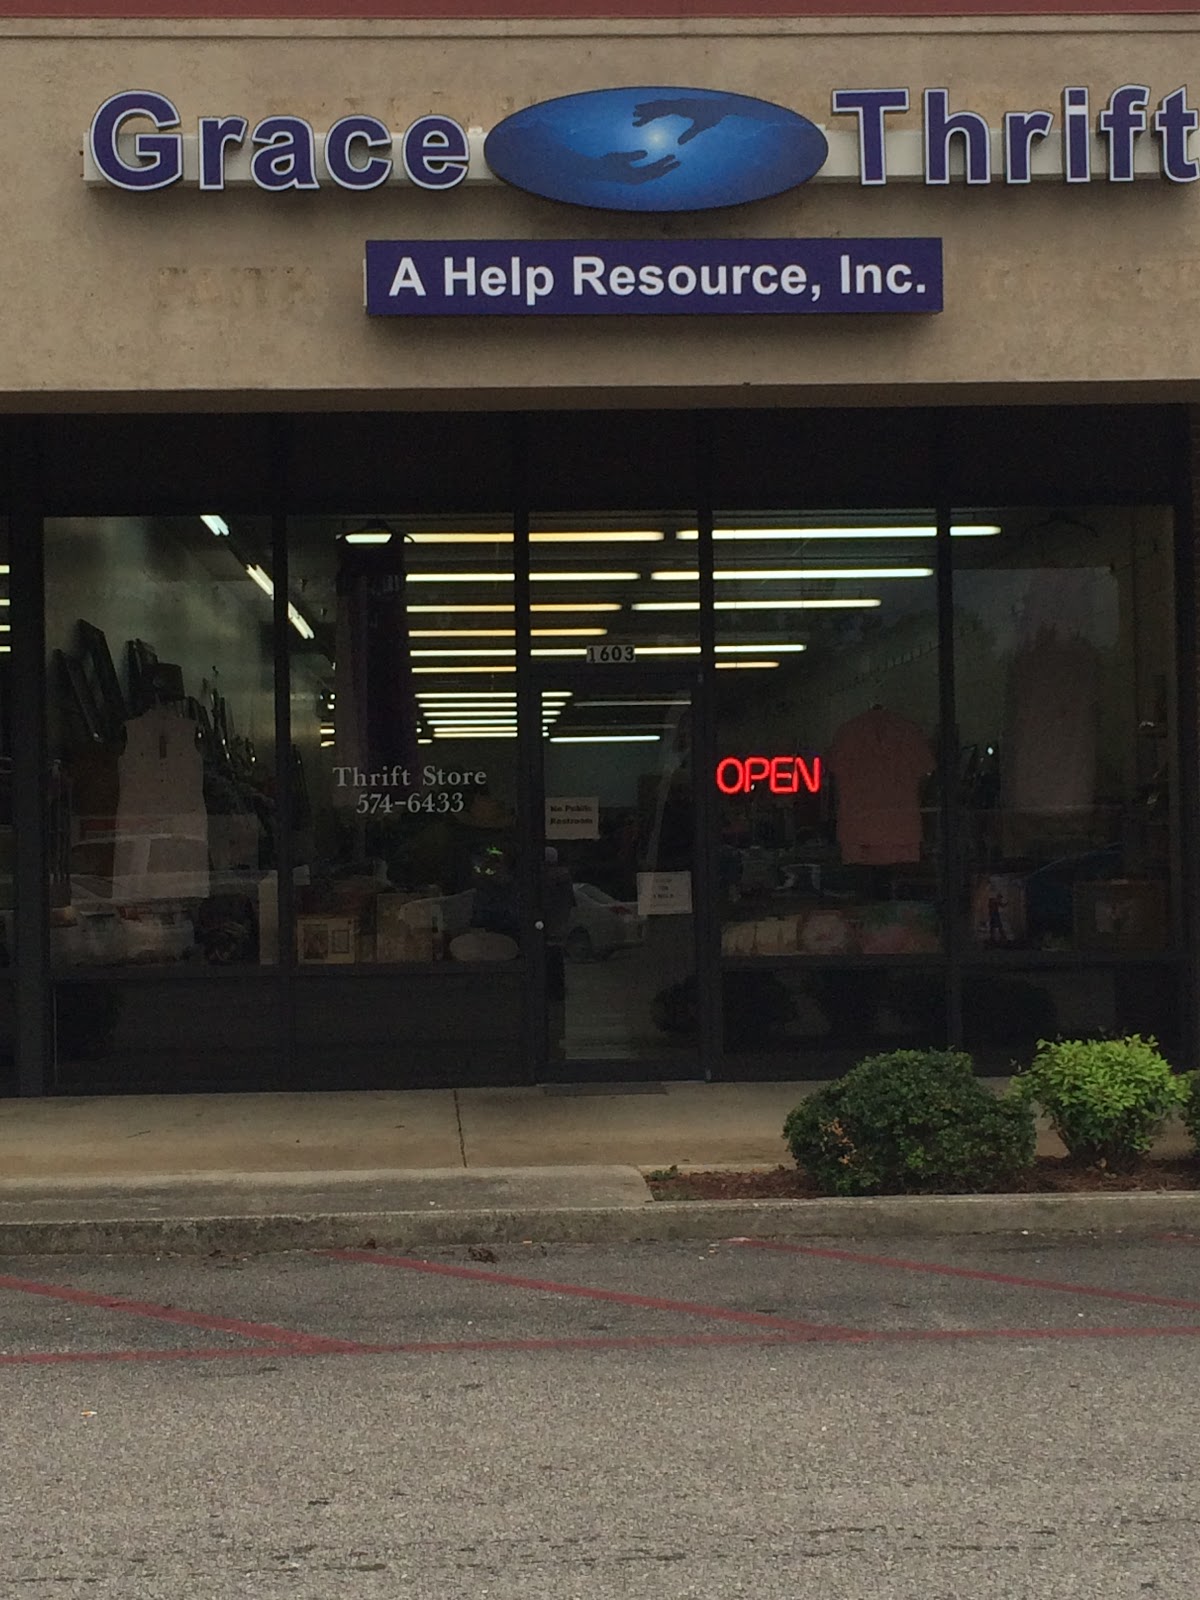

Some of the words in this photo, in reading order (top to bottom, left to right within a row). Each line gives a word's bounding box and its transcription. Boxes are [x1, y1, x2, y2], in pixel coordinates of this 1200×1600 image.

[90, 89, 470, 190] Grace
[832, 84, 1200, 185] Thrift
[389, 257, 426, 296] A
[444, 256, 554, 305] Help
[573, 256, 820, 302] Resource,
[840, 254, 926, 294] Inc.
[589, 646, 634, 661] 1603
[332, 765, 411, 787] Thrift
[422, 765, 487, 786] Store
[716, 757, 820, 793] OPEN
[356, 792, 464, 814] 574-6433
